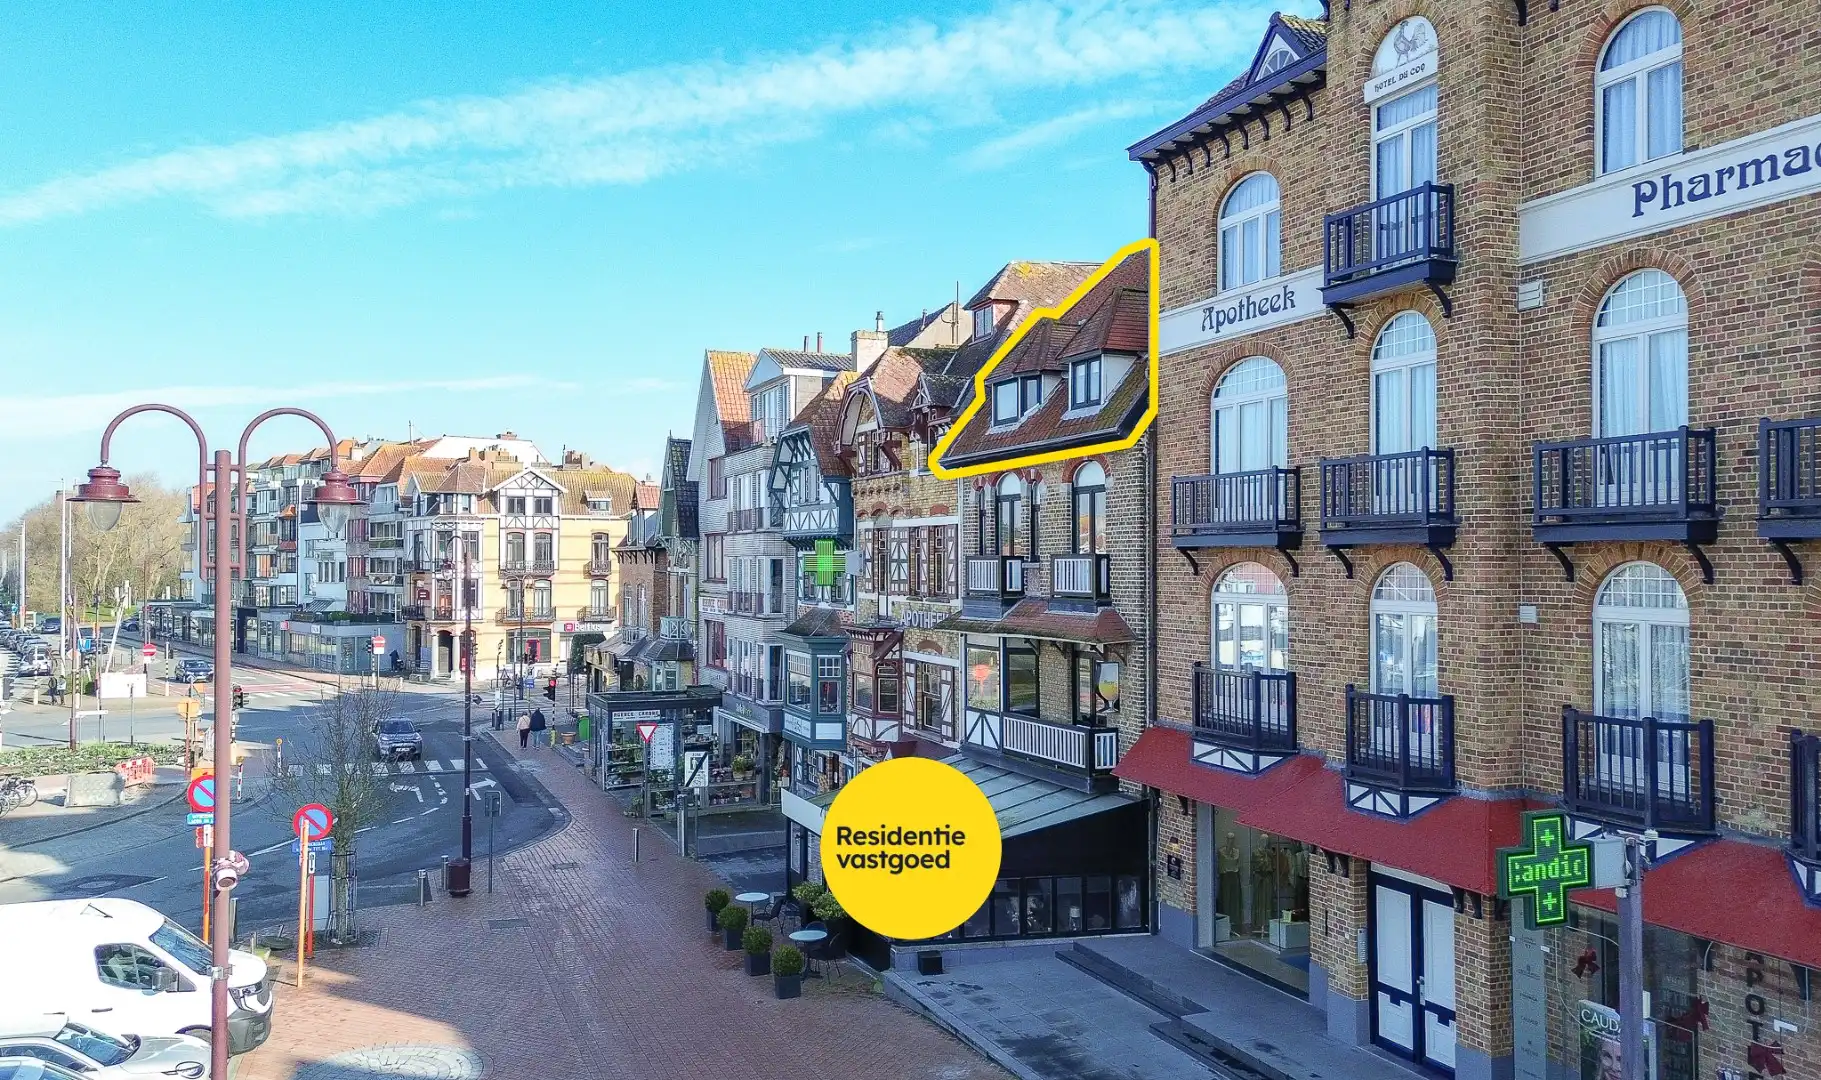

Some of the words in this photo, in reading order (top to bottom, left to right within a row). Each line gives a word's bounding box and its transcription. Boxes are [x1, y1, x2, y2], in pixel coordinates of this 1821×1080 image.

[1374, 77, 1397, 92] HOTEL
[1399, 70, 1408, 81] DU
[1410, 63, 1425, 76] COQ
[1201, 284, 1296, 334] Apotheek
